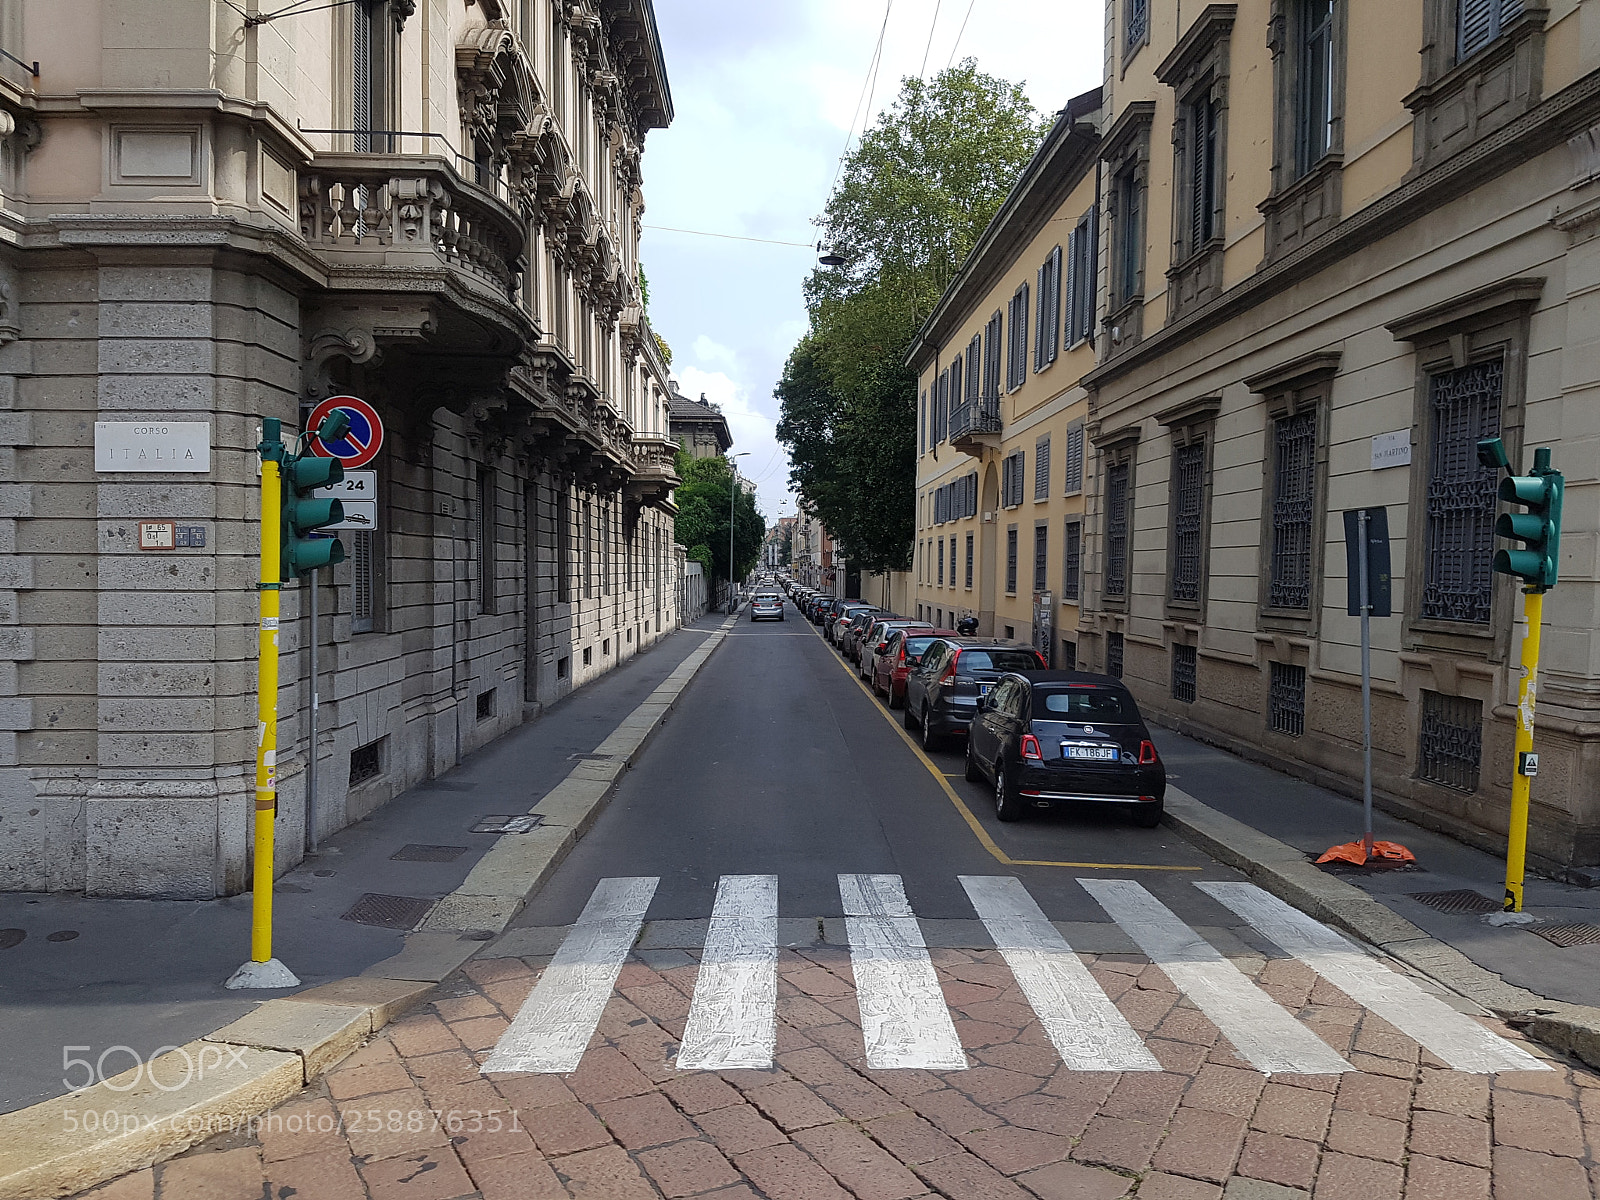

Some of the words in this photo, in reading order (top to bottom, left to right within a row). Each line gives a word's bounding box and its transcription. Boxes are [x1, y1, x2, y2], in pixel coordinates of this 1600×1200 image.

[133, 427, 169, 435] CORSO
[109, 448, 194, 460] ITALIA
[346, 480, 365, 491] 24
